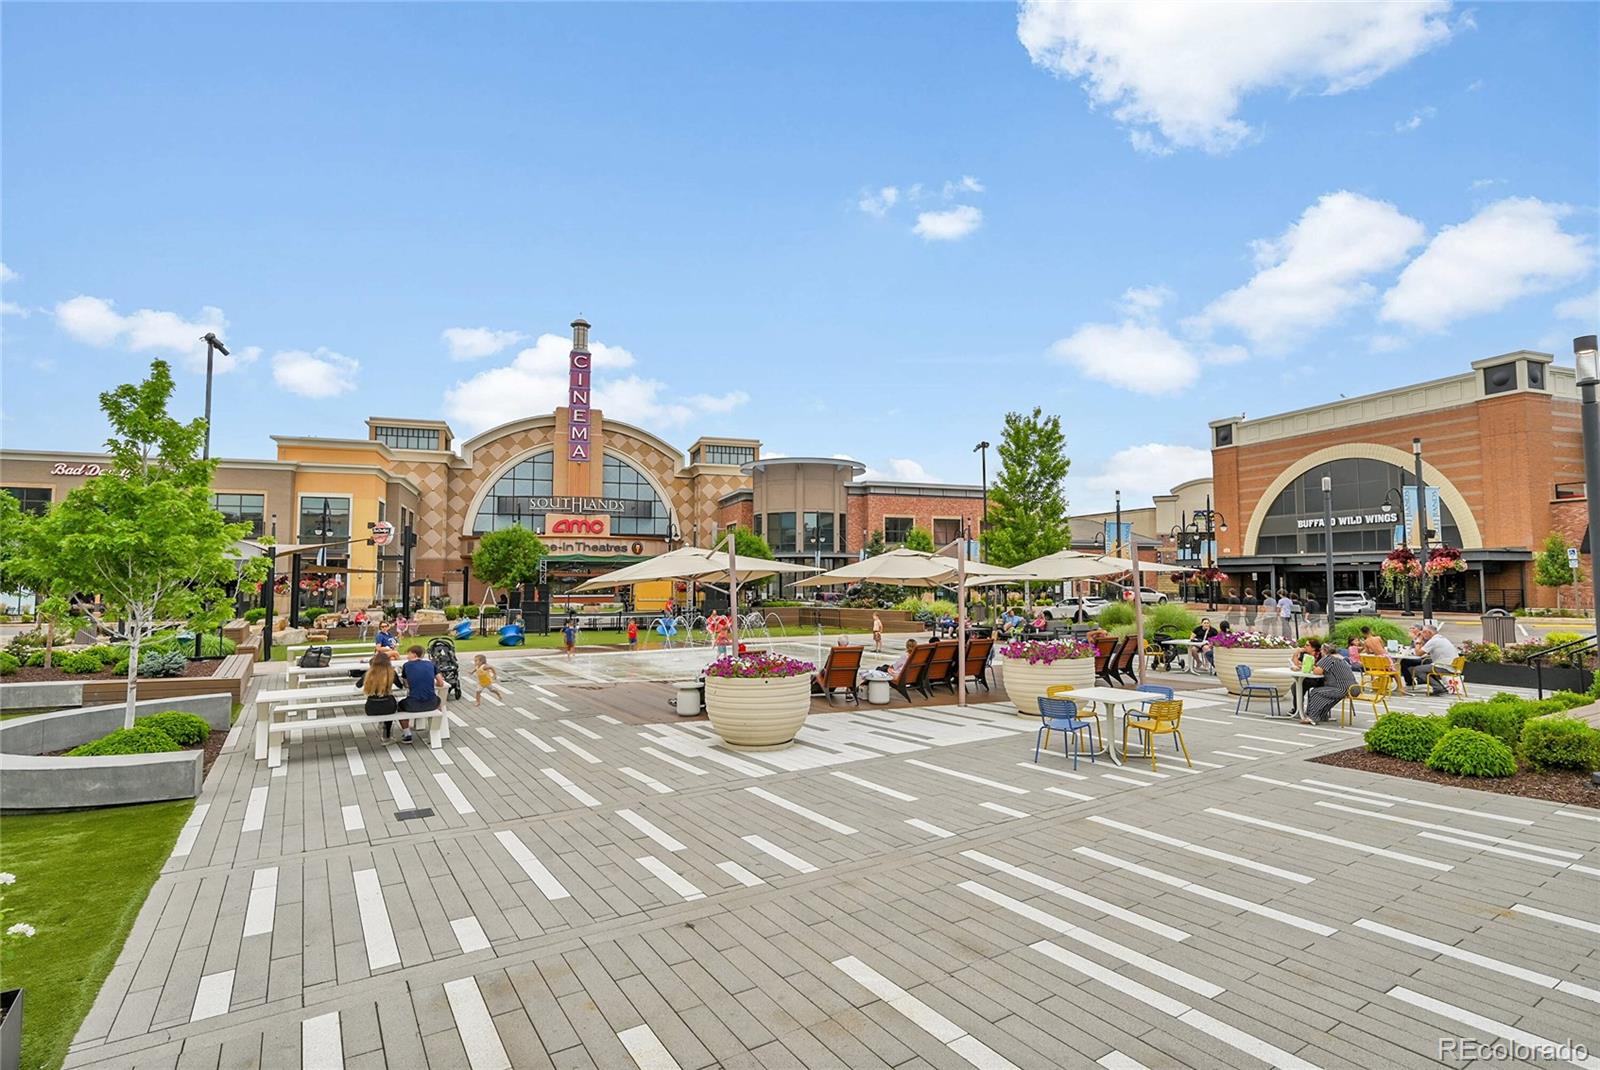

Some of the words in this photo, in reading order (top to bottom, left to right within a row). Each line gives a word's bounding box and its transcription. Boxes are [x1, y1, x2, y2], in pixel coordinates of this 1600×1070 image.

[571, 355, 589, 459] CINEMA
[50, 462, 86, 476] Bad
[528, 496, 625, 514] SOUTHLANDS
[1297, 517, 1336, 529] BUFFAO
[1338, 515, 1363, 527] WILD
[1364, 512, 1398, 525] WINGS
[575, 541, 628, 553] Theatres
